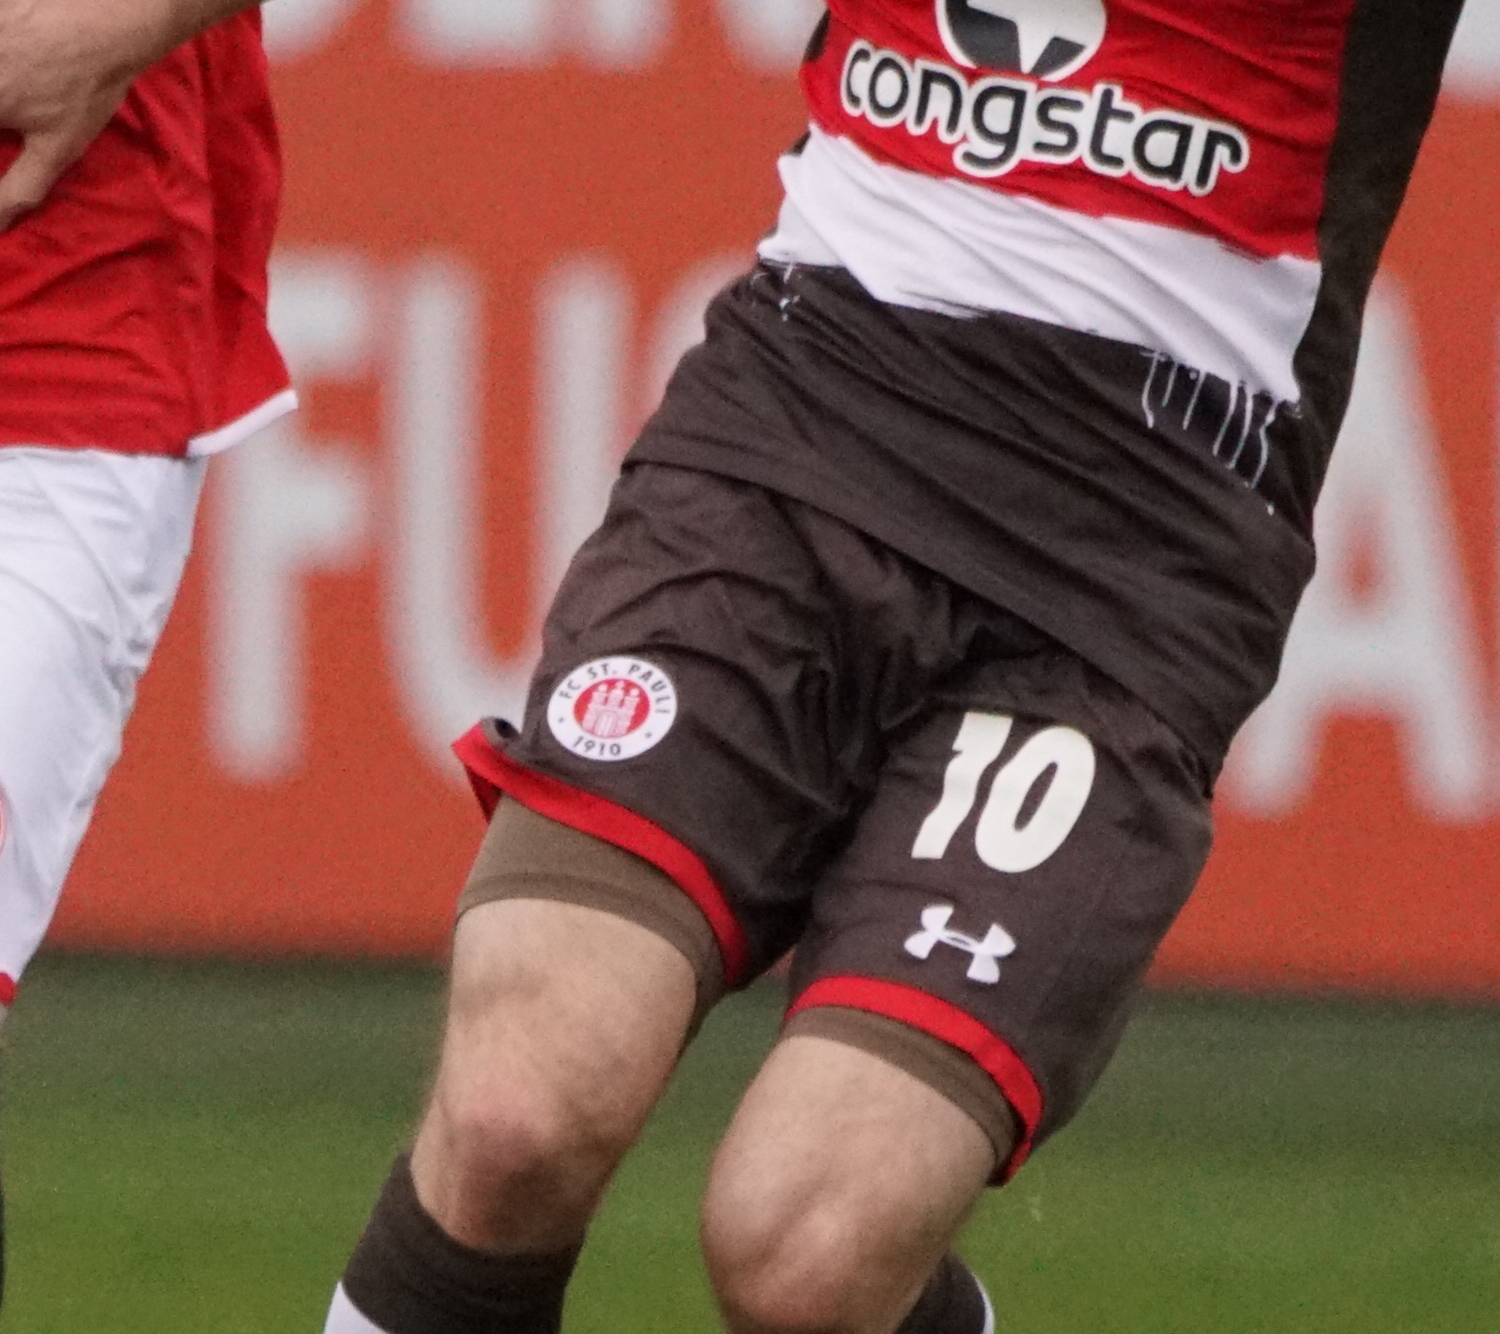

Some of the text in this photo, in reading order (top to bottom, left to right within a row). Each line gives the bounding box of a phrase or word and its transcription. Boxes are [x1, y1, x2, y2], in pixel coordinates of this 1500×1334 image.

[842, 43, 1247, 195] congstar
[558, 679, 582, 700] FC
[627, 663, 672, 714] PAULI
[573, 736, 622, 757] 1910
[910, 711, 1097, 873] 10
